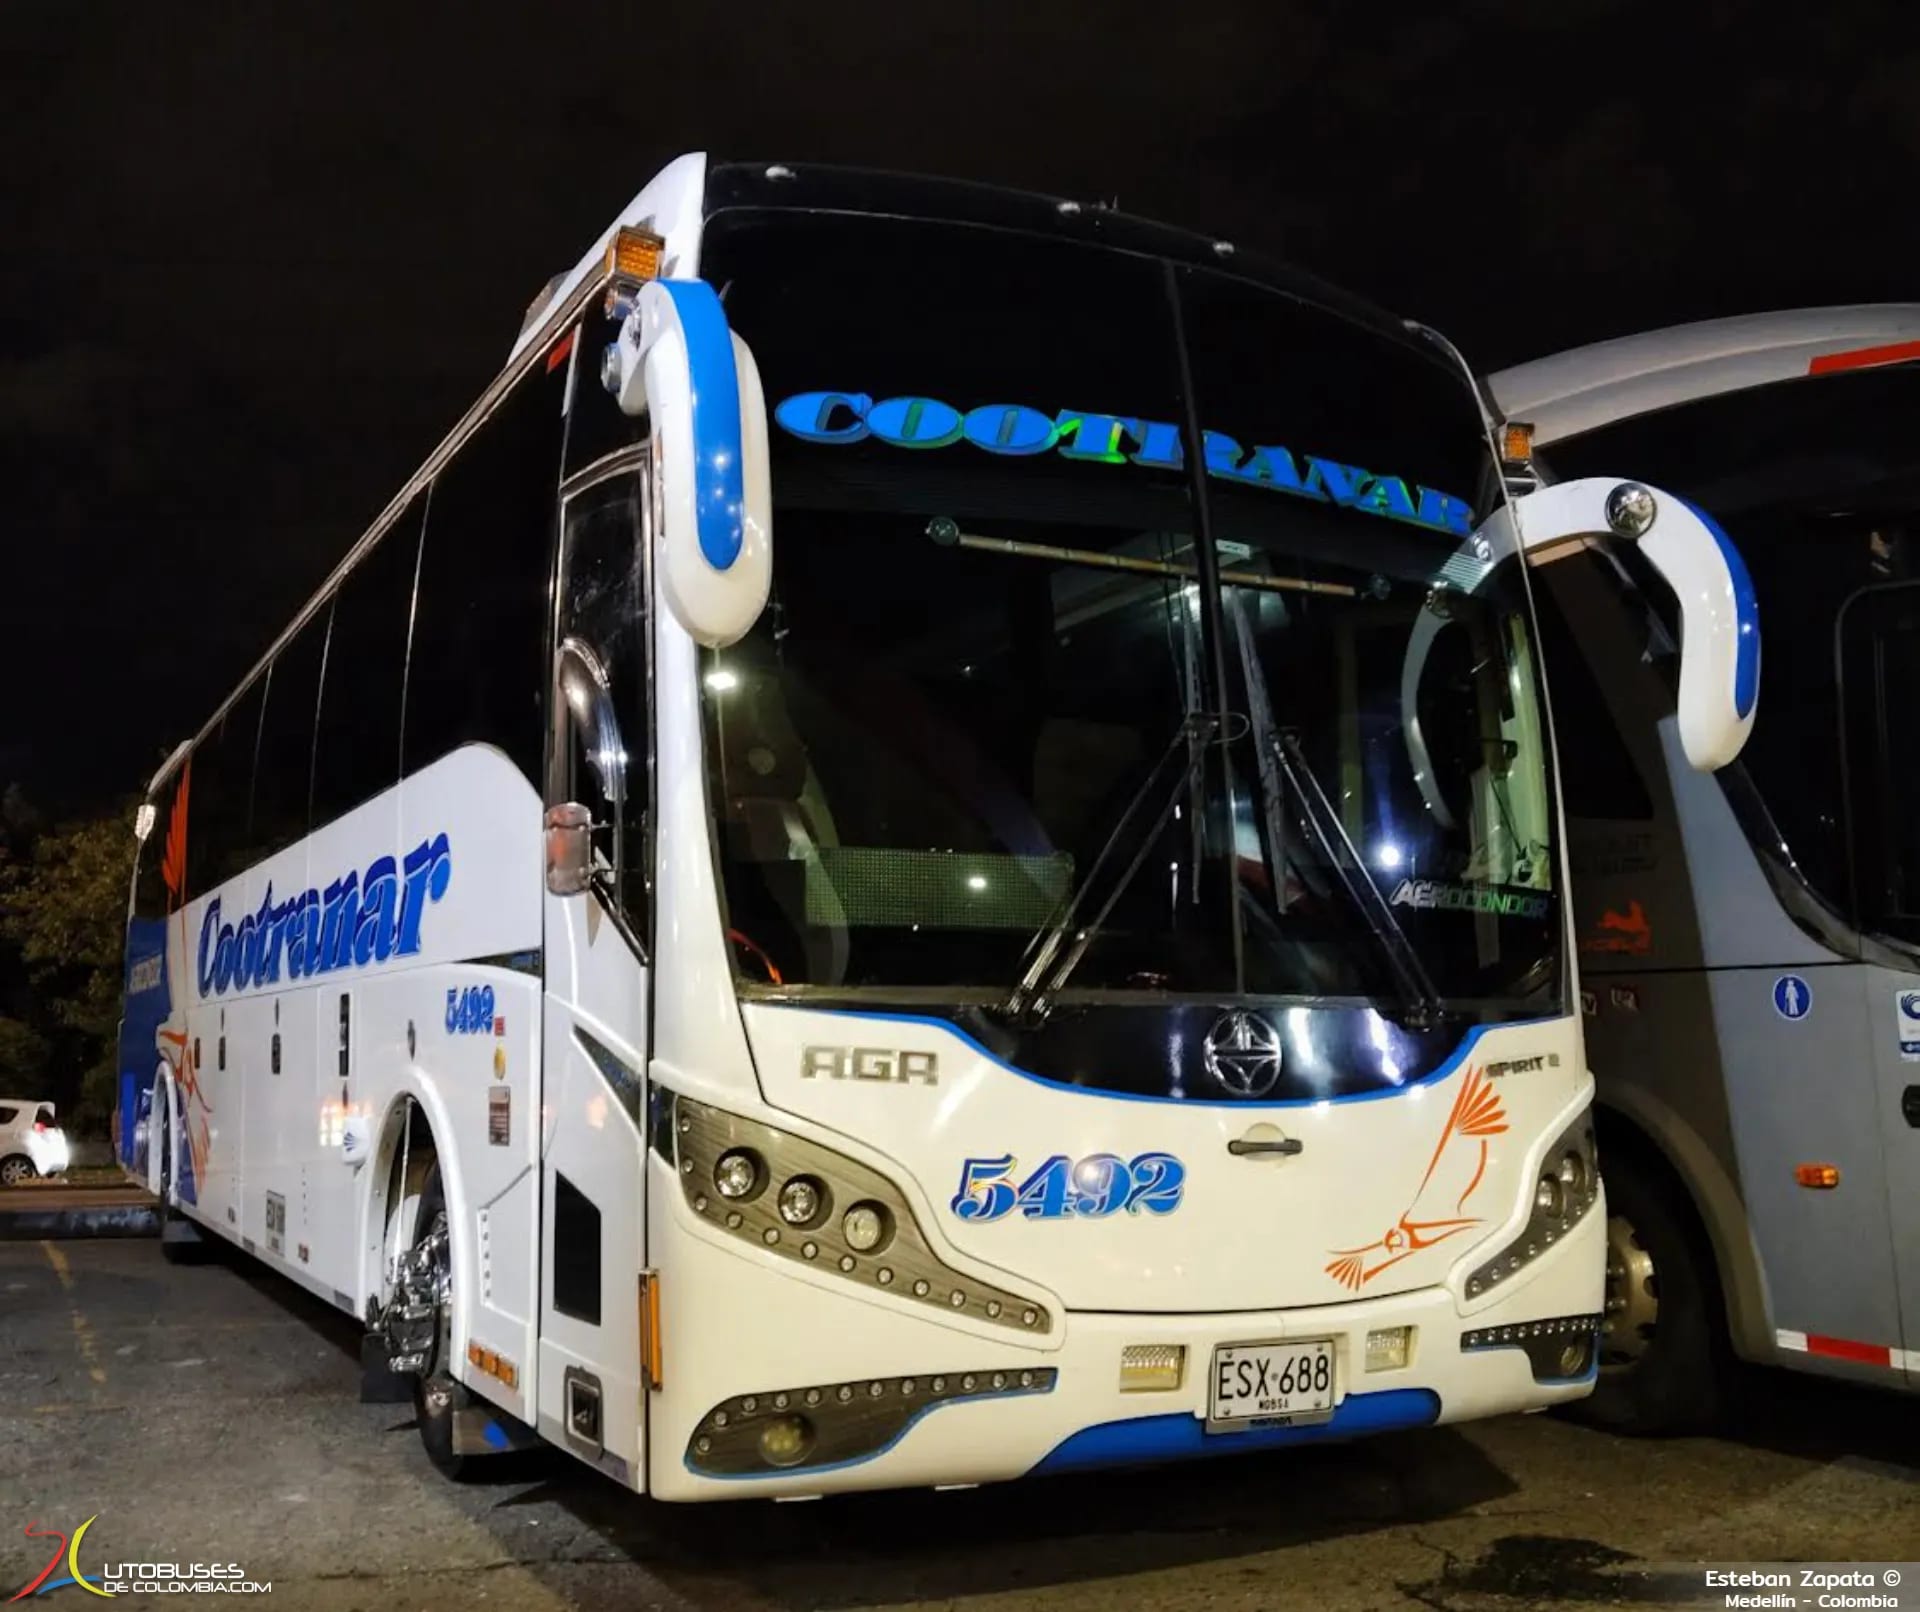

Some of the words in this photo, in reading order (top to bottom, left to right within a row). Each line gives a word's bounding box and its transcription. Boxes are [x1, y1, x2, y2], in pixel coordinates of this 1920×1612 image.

[775, 391, 1473, 537] COOTRANAR
[197, 832, 451, 998] Cootranar
[445, 984, 494, 1035] 5492
[801, 1046, 939, 1086] AGA
[951, 1152, 1186, 1224] 5492
